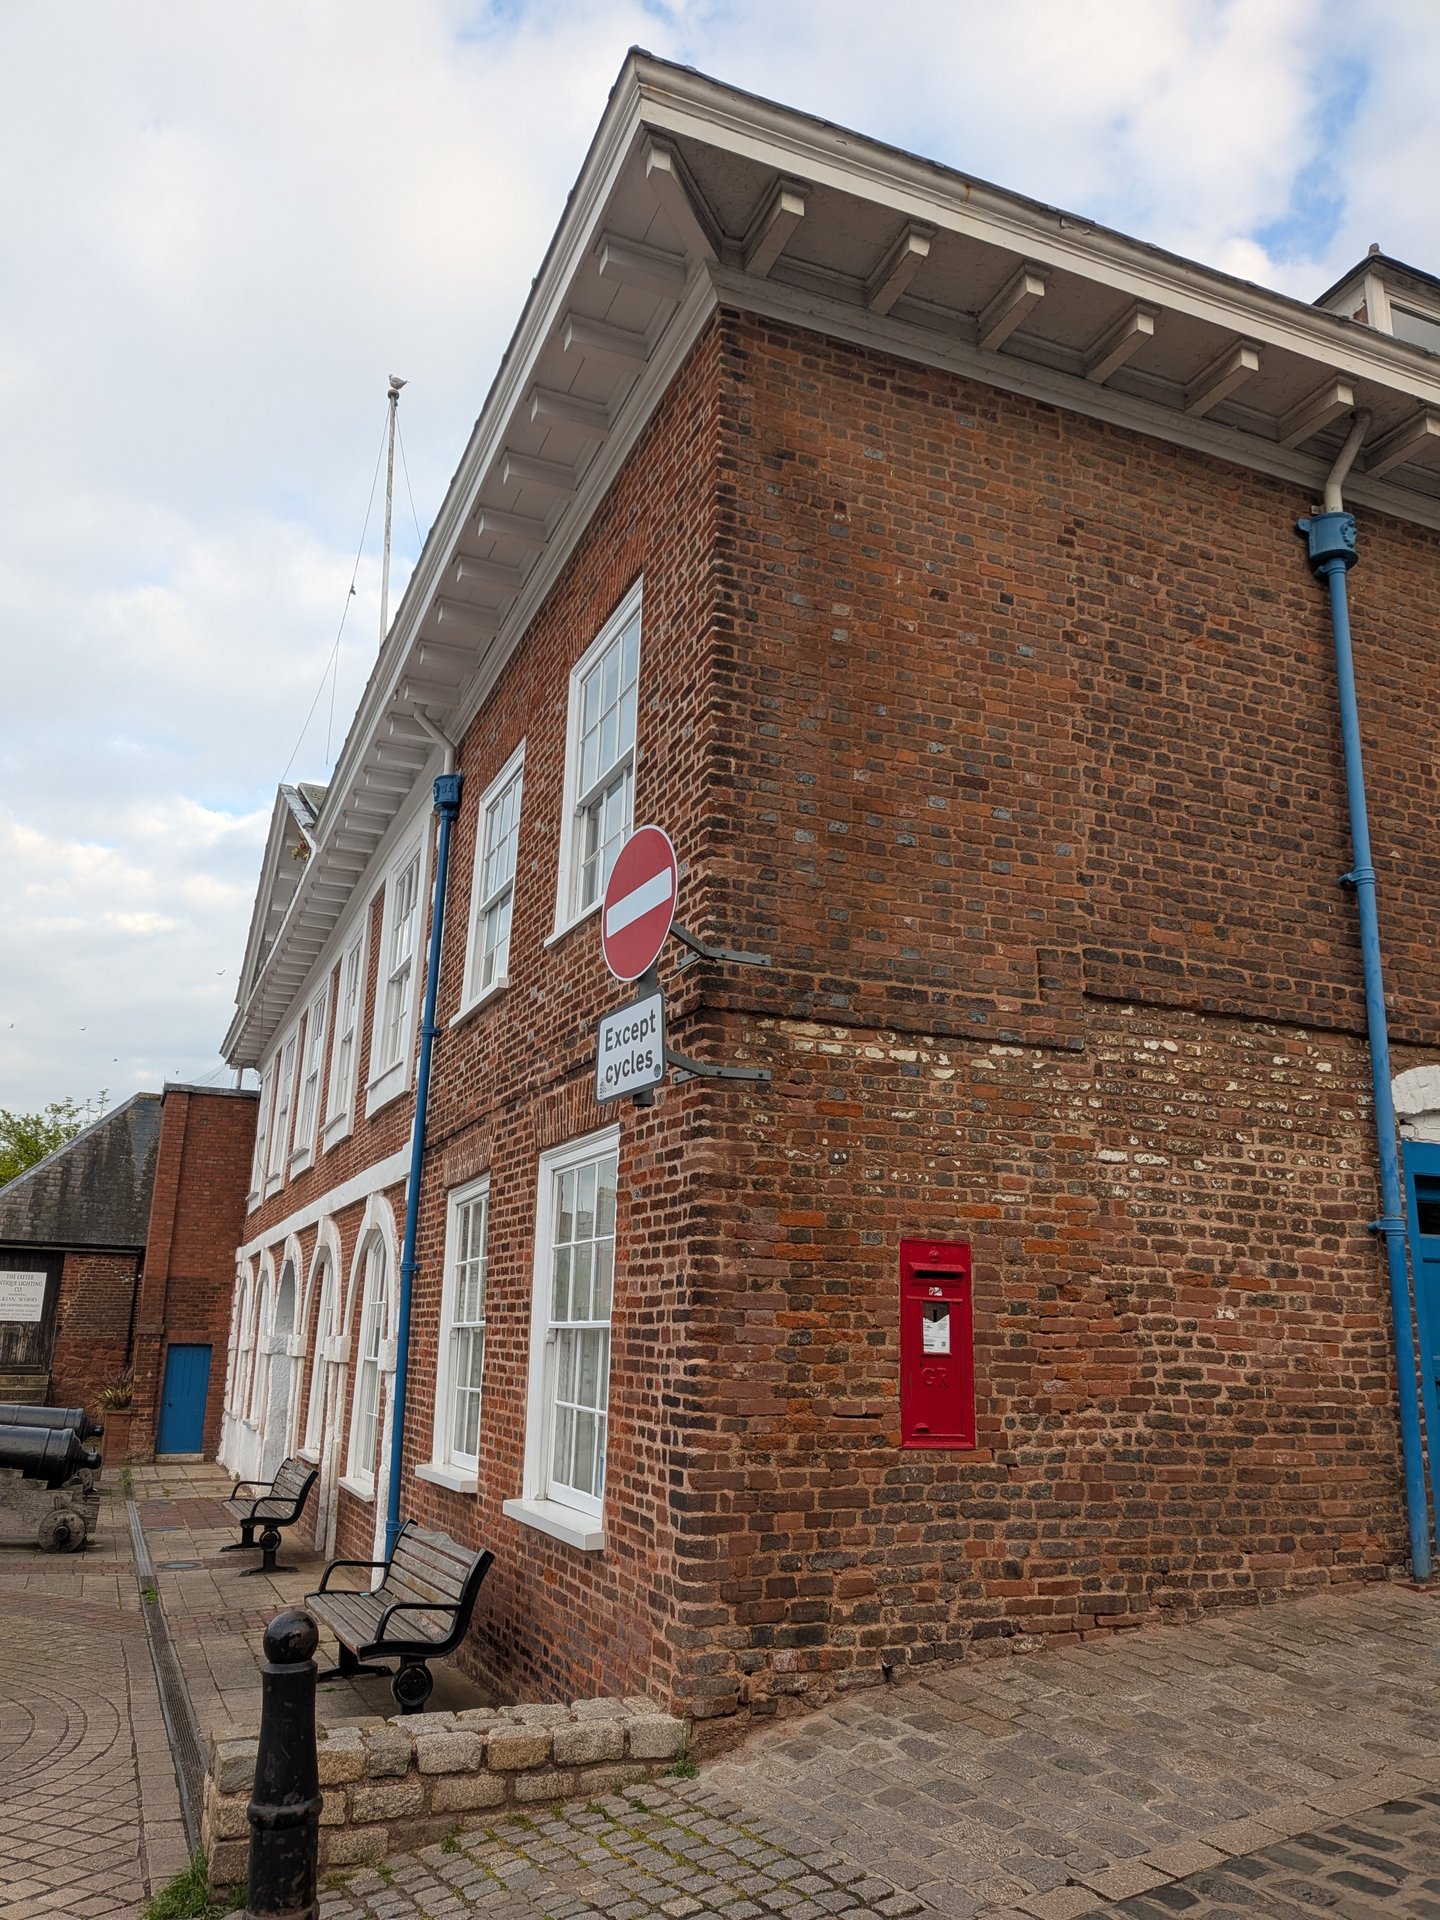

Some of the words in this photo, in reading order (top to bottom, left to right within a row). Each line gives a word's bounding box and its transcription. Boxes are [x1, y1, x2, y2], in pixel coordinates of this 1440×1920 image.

[605, 1008, 656, 1053] Except
[605, 1049, 653, 1086] cycles
[921, 1367, 950, 1388] GR
